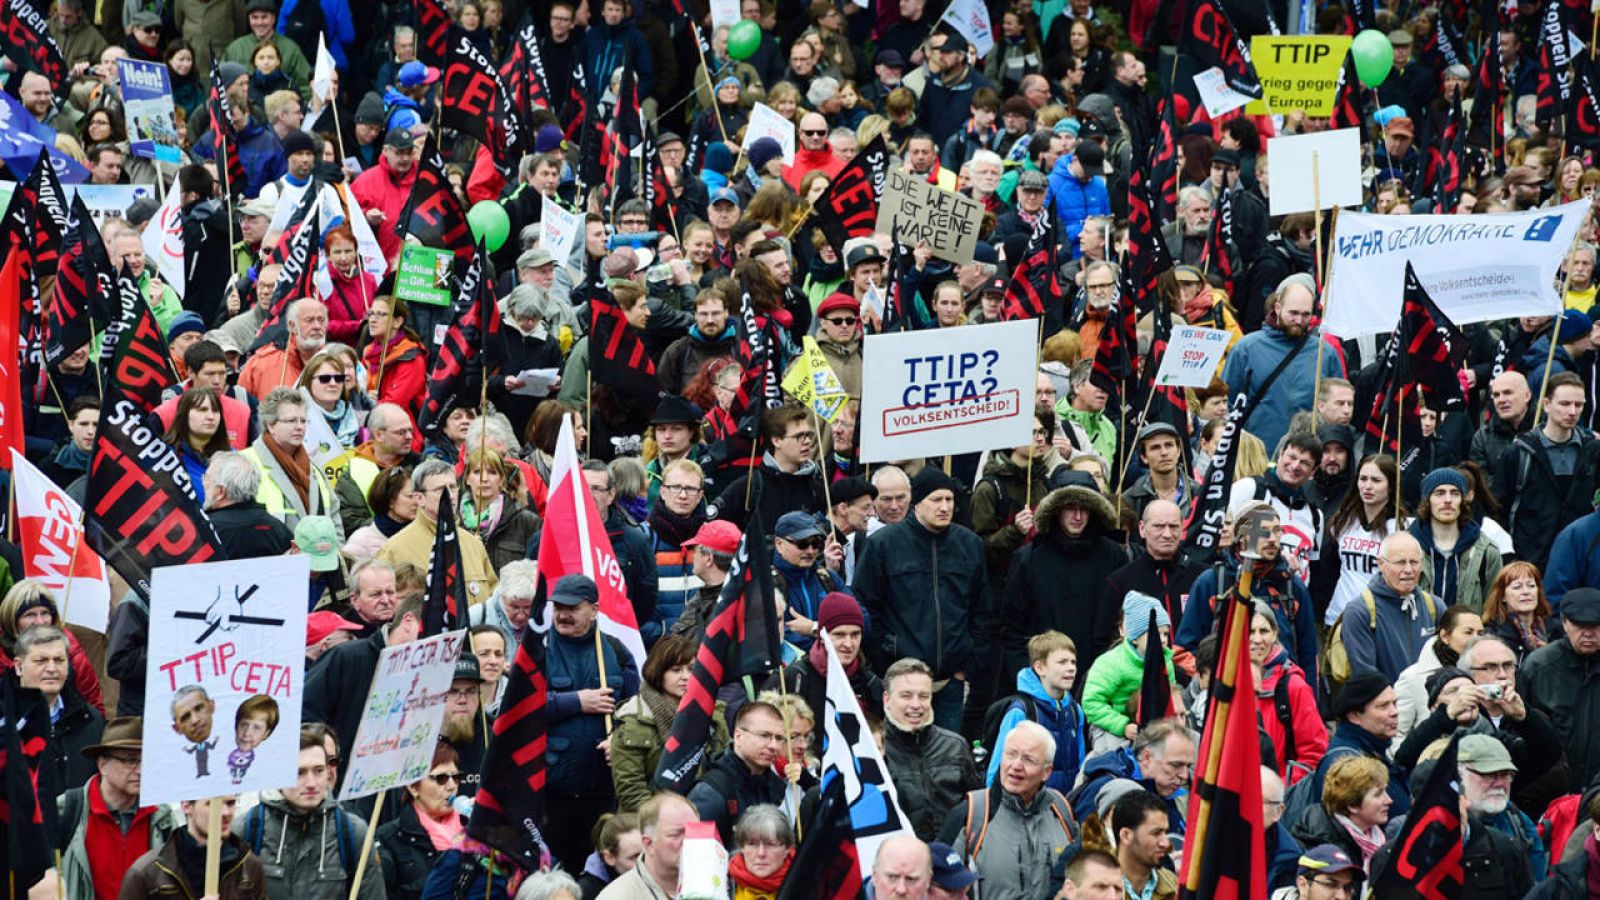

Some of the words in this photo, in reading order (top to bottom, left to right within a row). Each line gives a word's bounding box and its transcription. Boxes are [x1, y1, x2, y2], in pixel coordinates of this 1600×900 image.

[1271, 44, 1330, 64] TTIP
[123, 61, 163, 87] Nein!
[1269, 96, 1322, 110] Europa
[890, 173, 918, 199] DIE
[926, 188, 978, 220] WELT
[894, 213, 947, 251] WARE
[900, 200, 922, 218] IST
[928, 210, 974, 236] KEINE
[904, 349, 1000, 383] TTIP?
[1183, 350, 1205, 361] STOP
[902, 376, 999, 411] CETA?
[892, 400, 1011, 428] VOLKSENTSCHEID!
[107, 399, 198, 501] Stoppen
[1195, 506, 1226, 549] Sie
[159, 641, 236, 692] TTIP
[230, 660, 291, 698] CETA
